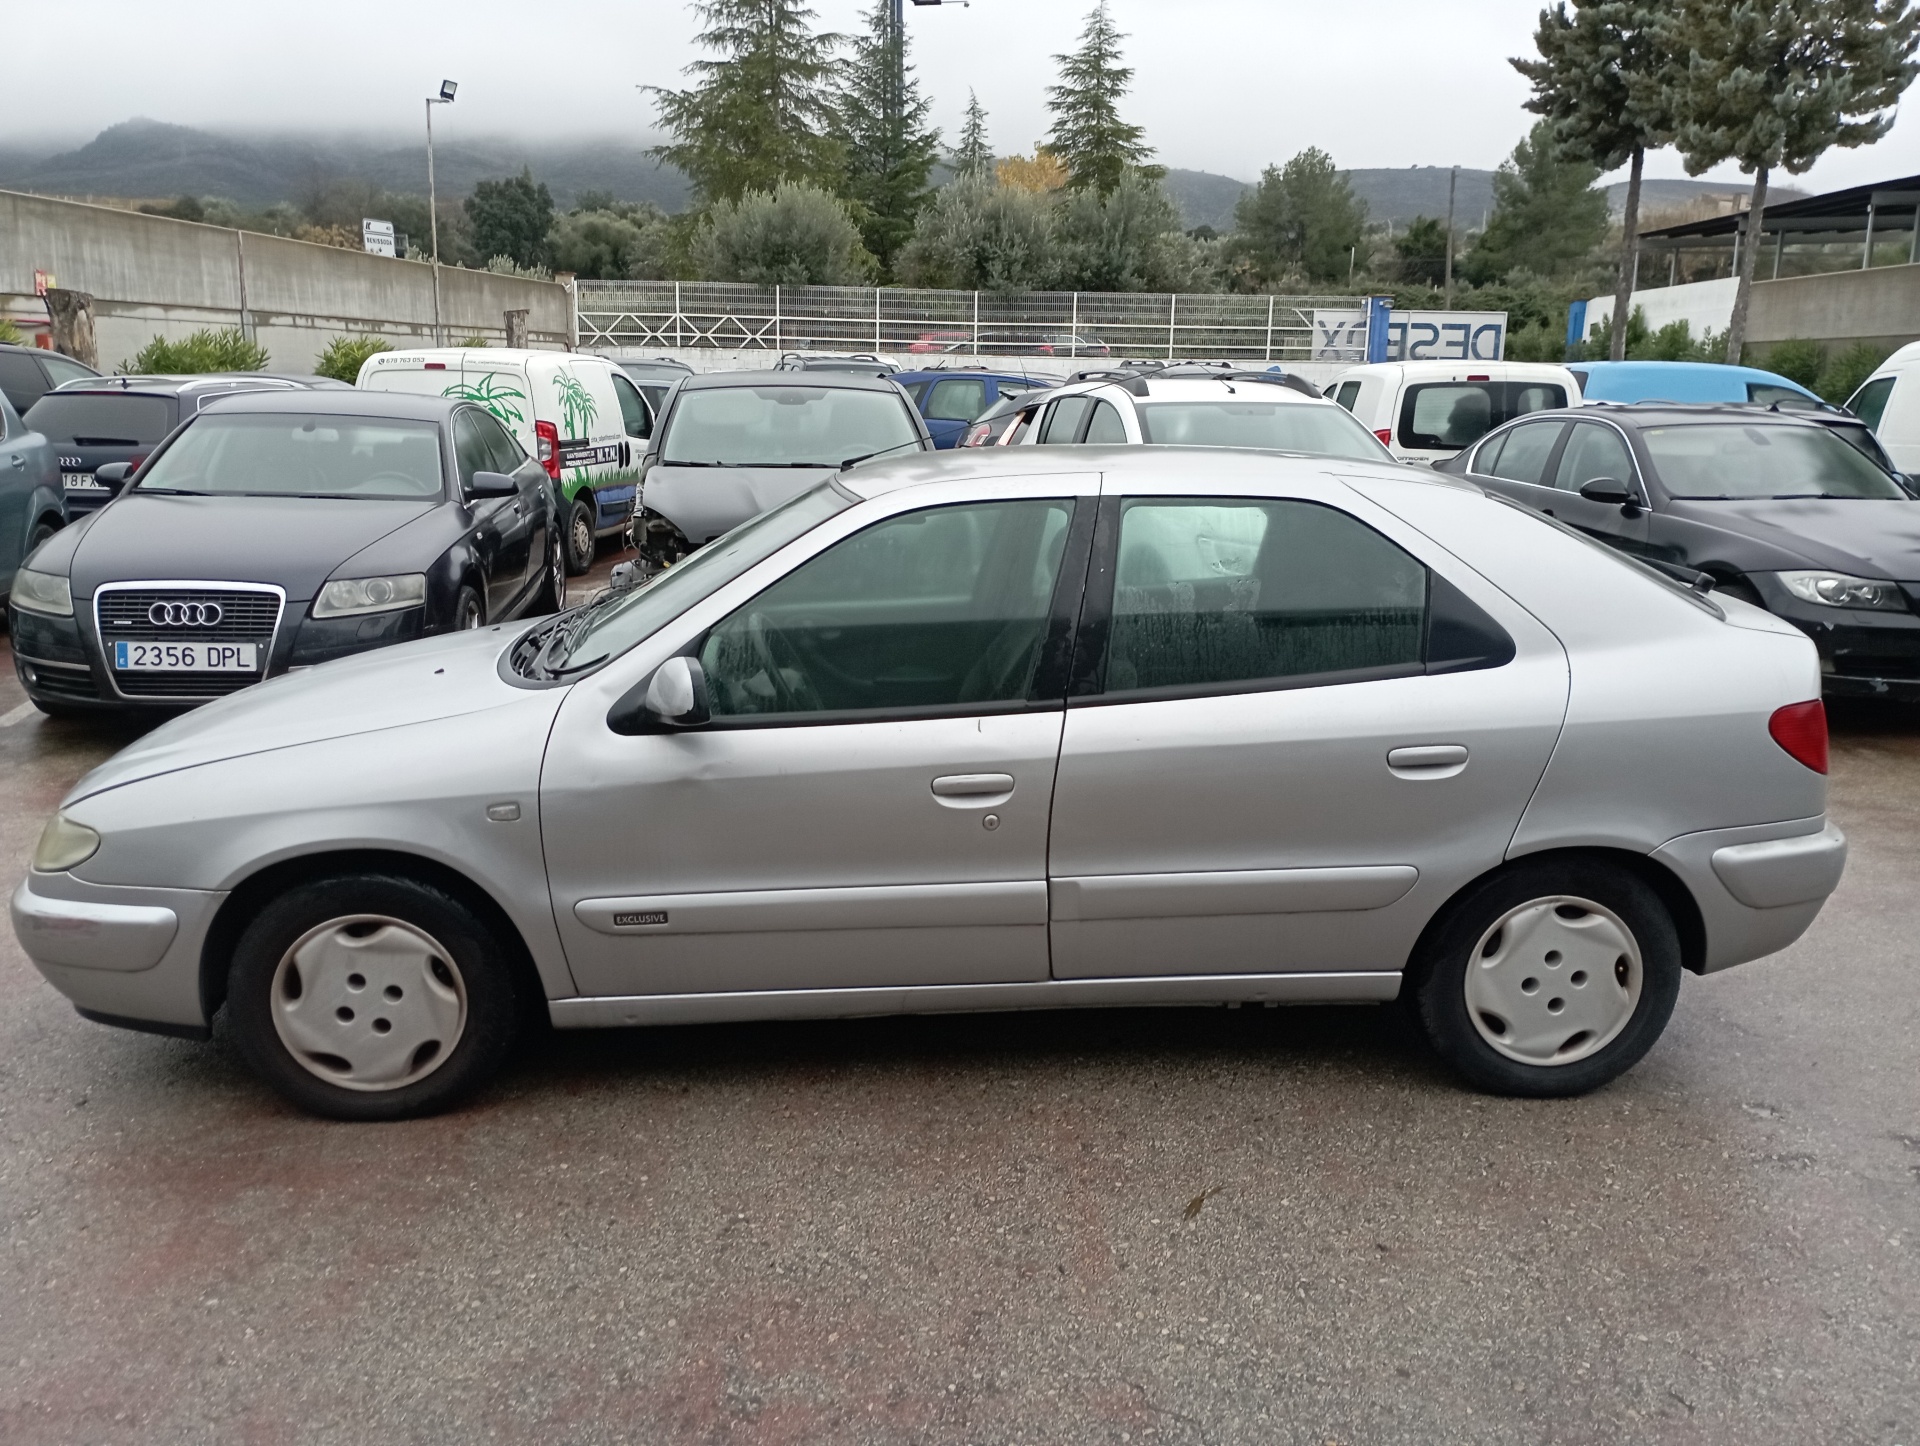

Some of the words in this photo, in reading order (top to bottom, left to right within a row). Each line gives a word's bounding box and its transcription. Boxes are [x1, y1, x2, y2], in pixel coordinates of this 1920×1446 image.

[64, 474, 97, 487] 18FX
[133, 645, 196, 667] 2356
[207, 646, 250, 667] DPL
[616, 914, 665, 924] EXCLUSIVE
